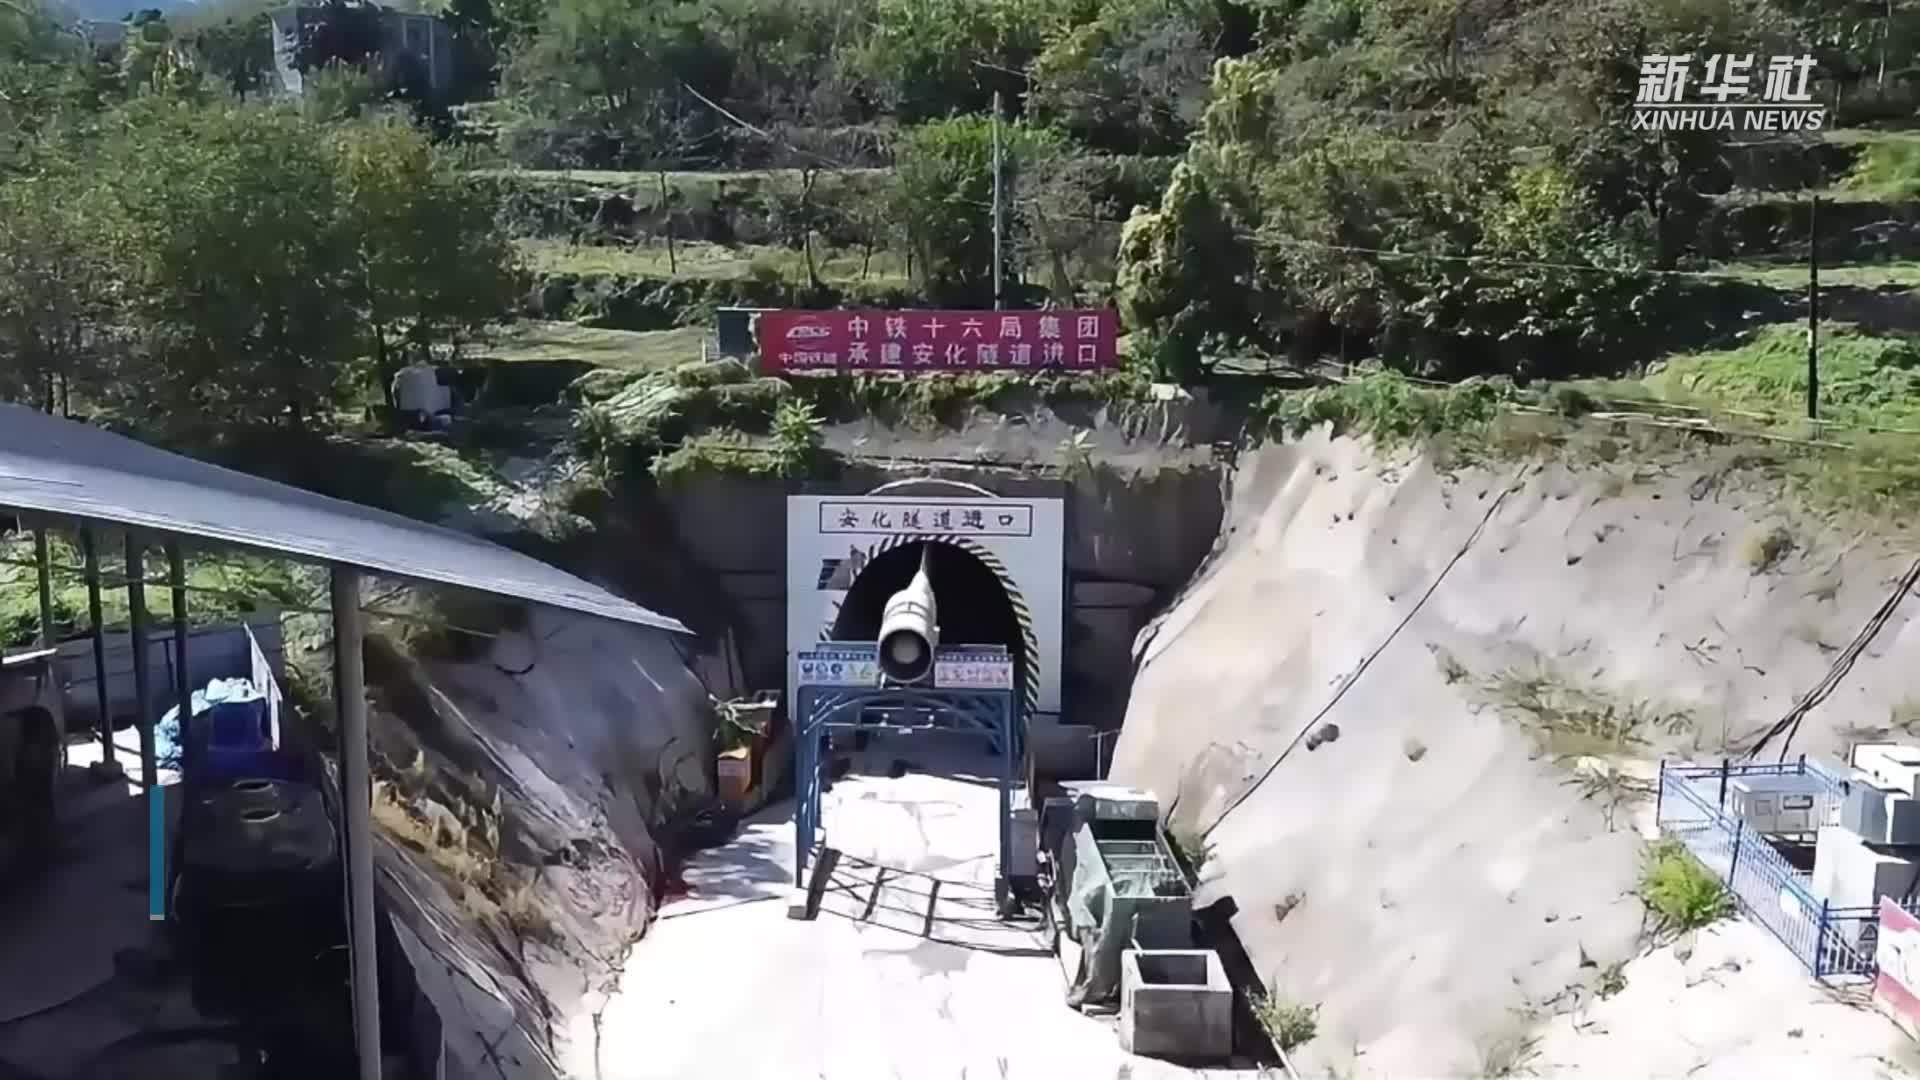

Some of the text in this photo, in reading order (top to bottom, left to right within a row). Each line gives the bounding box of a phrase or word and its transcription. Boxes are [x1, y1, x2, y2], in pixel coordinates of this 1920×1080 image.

[848, 315, 1099, 339] 中铁十六局集团
